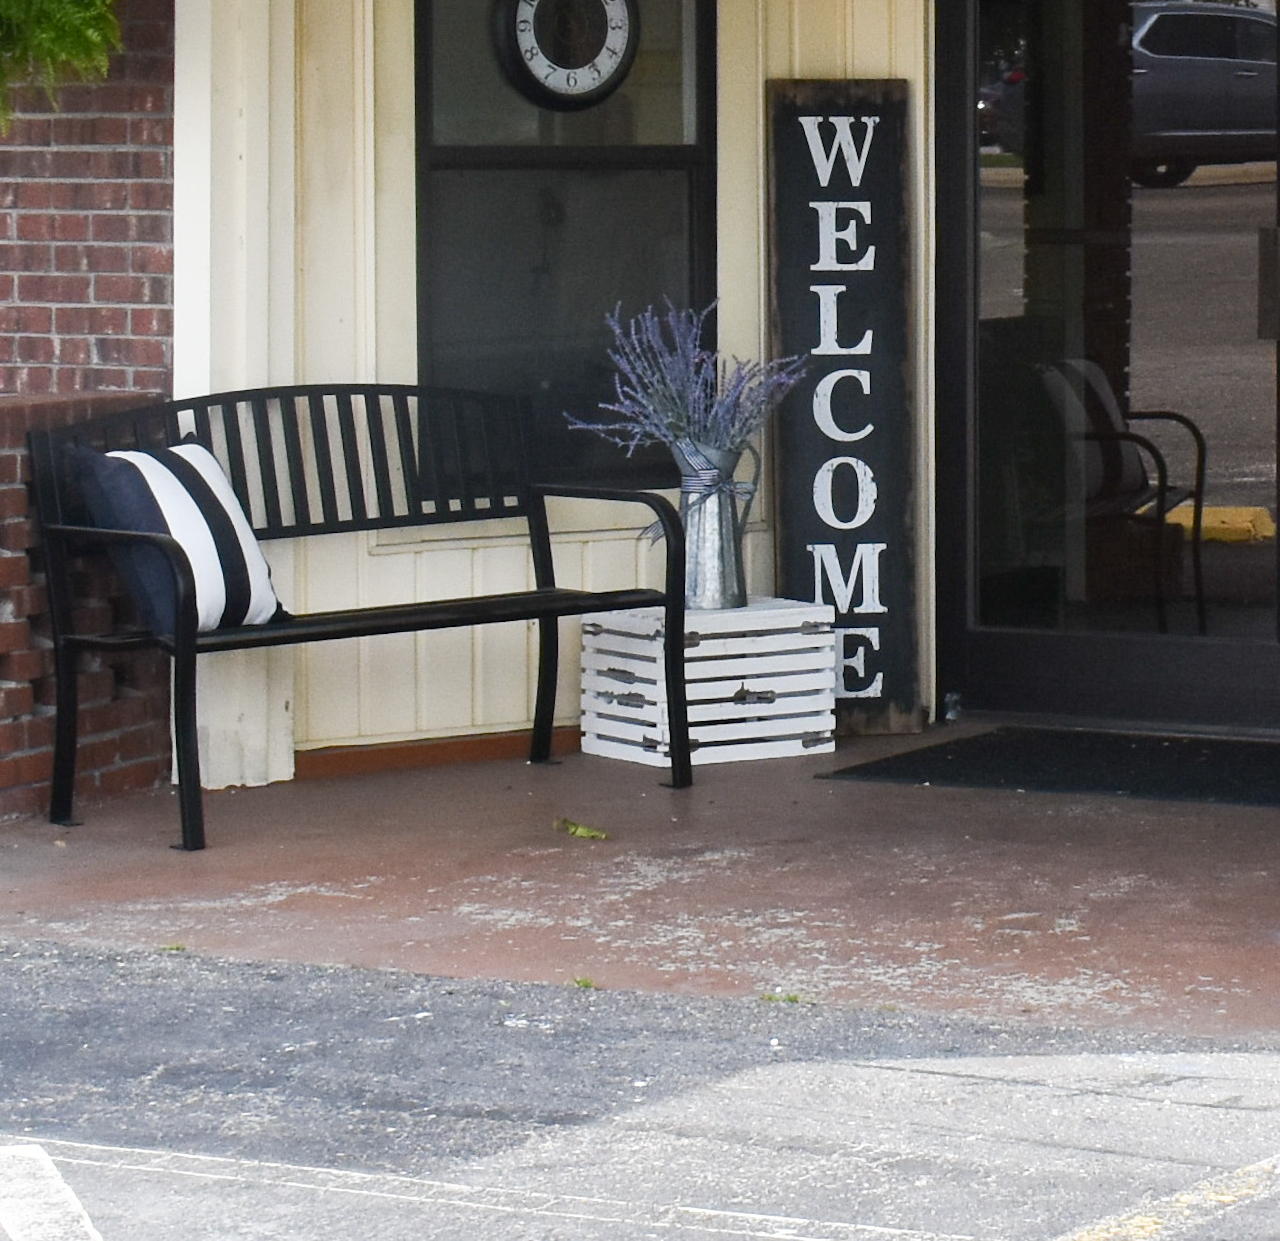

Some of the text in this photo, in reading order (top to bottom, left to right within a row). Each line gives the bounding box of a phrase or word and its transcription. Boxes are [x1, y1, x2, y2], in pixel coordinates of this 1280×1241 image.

[518, 19, 531, 33] 9
[609, 17, 623, 31] 3
[524, 45, 539, 61] 8
[605, 45, 618, 59] 4
[544, 64, 557, 81] 7
[566, 71, 578, 88] 6
[587, 62, 601, 81] 5
[798, 115, 889, 699] WELCOME
